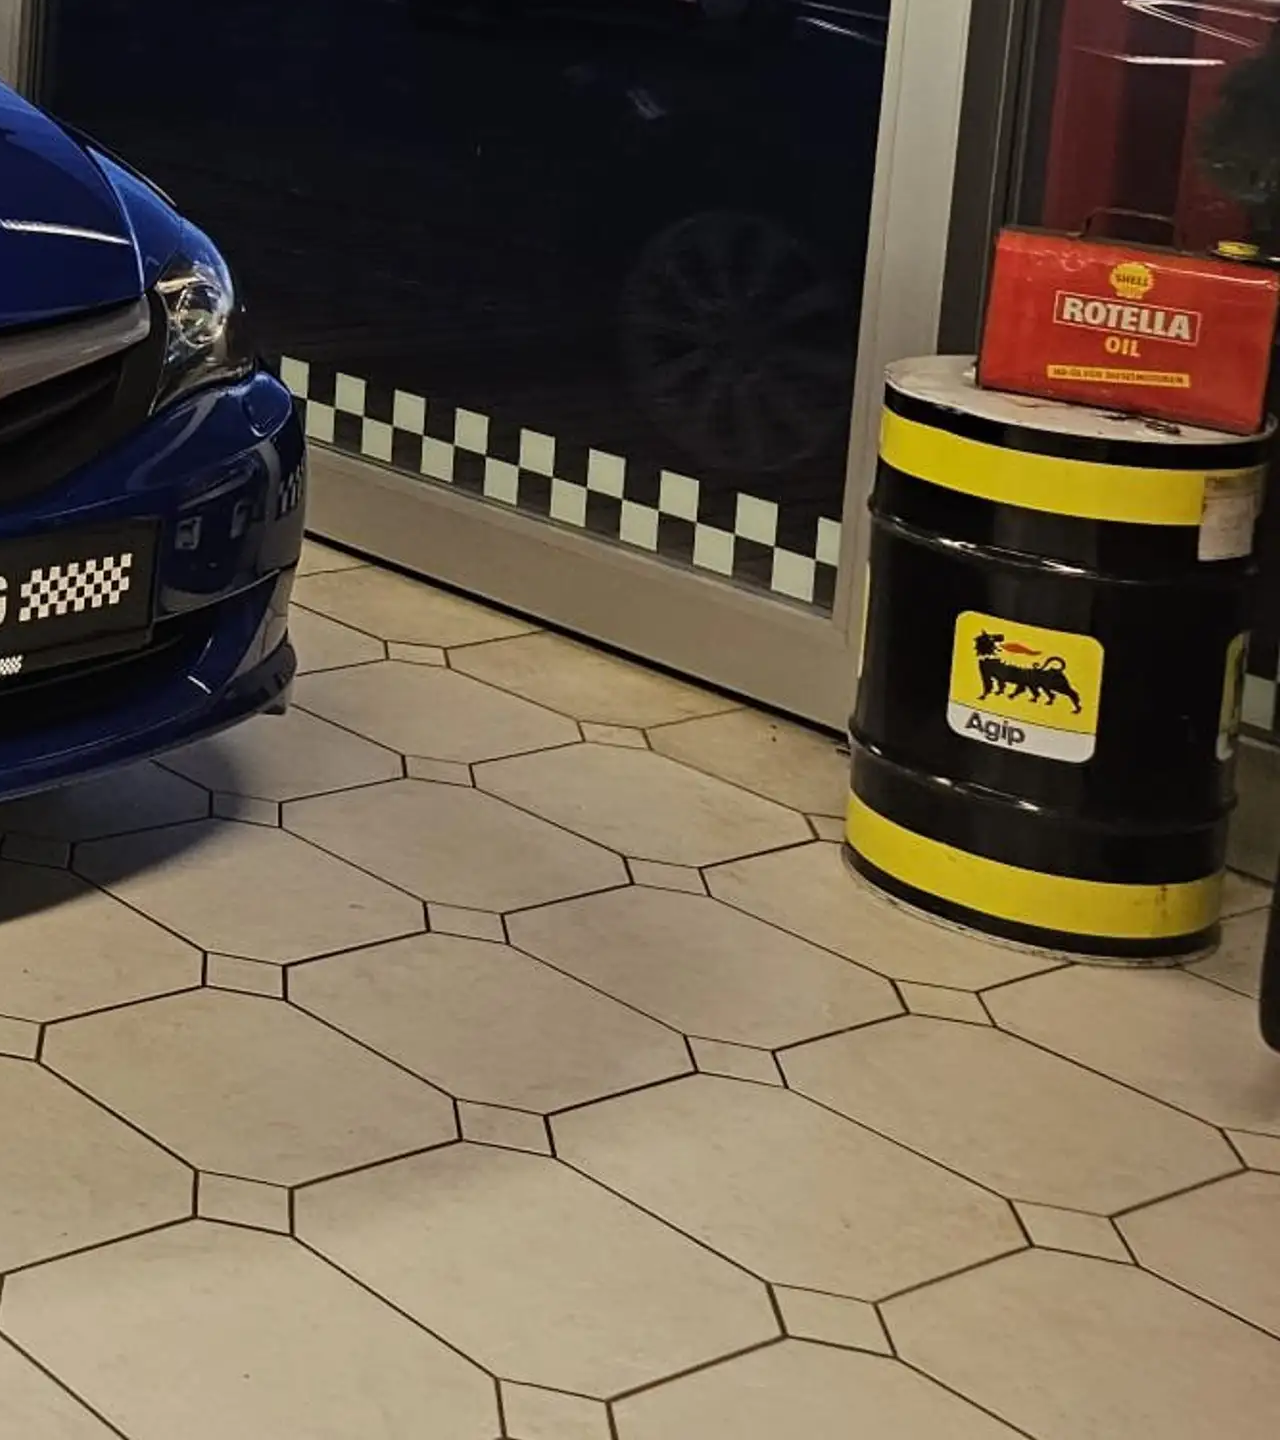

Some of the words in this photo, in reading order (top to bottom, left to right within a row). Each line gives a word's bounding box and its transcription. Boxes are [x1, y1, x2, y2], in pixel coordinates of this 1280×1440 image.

[1115, 272, 1148, 287] SHELL
[1062, 296, 1191, 341] ROTELLA
[1104, 335, 1141, 358] OIL
[964, 709, 1026, 747] Agip
